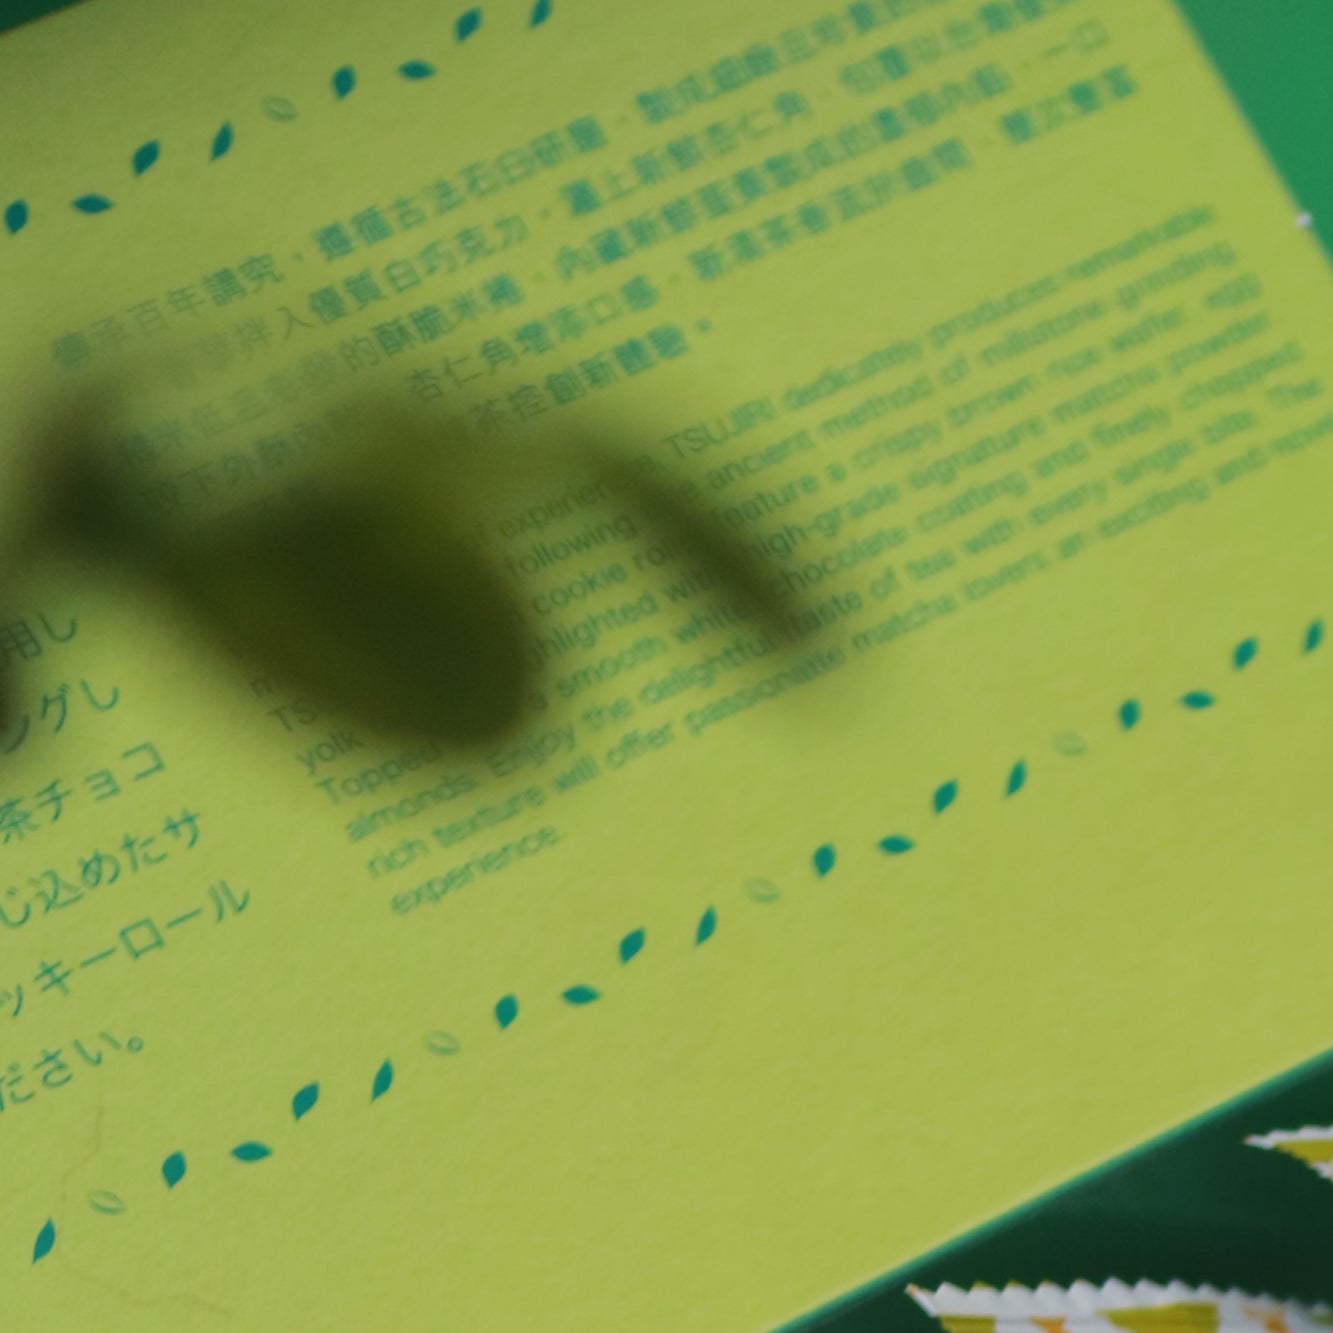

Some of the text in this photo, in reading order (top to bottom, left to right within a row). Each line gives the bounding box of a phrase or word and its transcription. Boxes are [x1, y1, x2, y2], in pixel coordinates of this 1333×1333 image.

[507, 512, 637, 568] following
[534, 566, 624, 612] cookie
[297, 727, 363, 775] yolk
[522, 596, 656, 672] ghlighted
[317, 738, 442, 800] Topped
[556, 639, 657, 697] smooth
[482, 728, 573, 775] Enjoy
[583, 701, 630, 729] the
[642, 630, 776, 700] delightful
[367, 841, 423, 877] rich
[553, 756, 598, 791] will
[607, 724, 672, 766] offer
